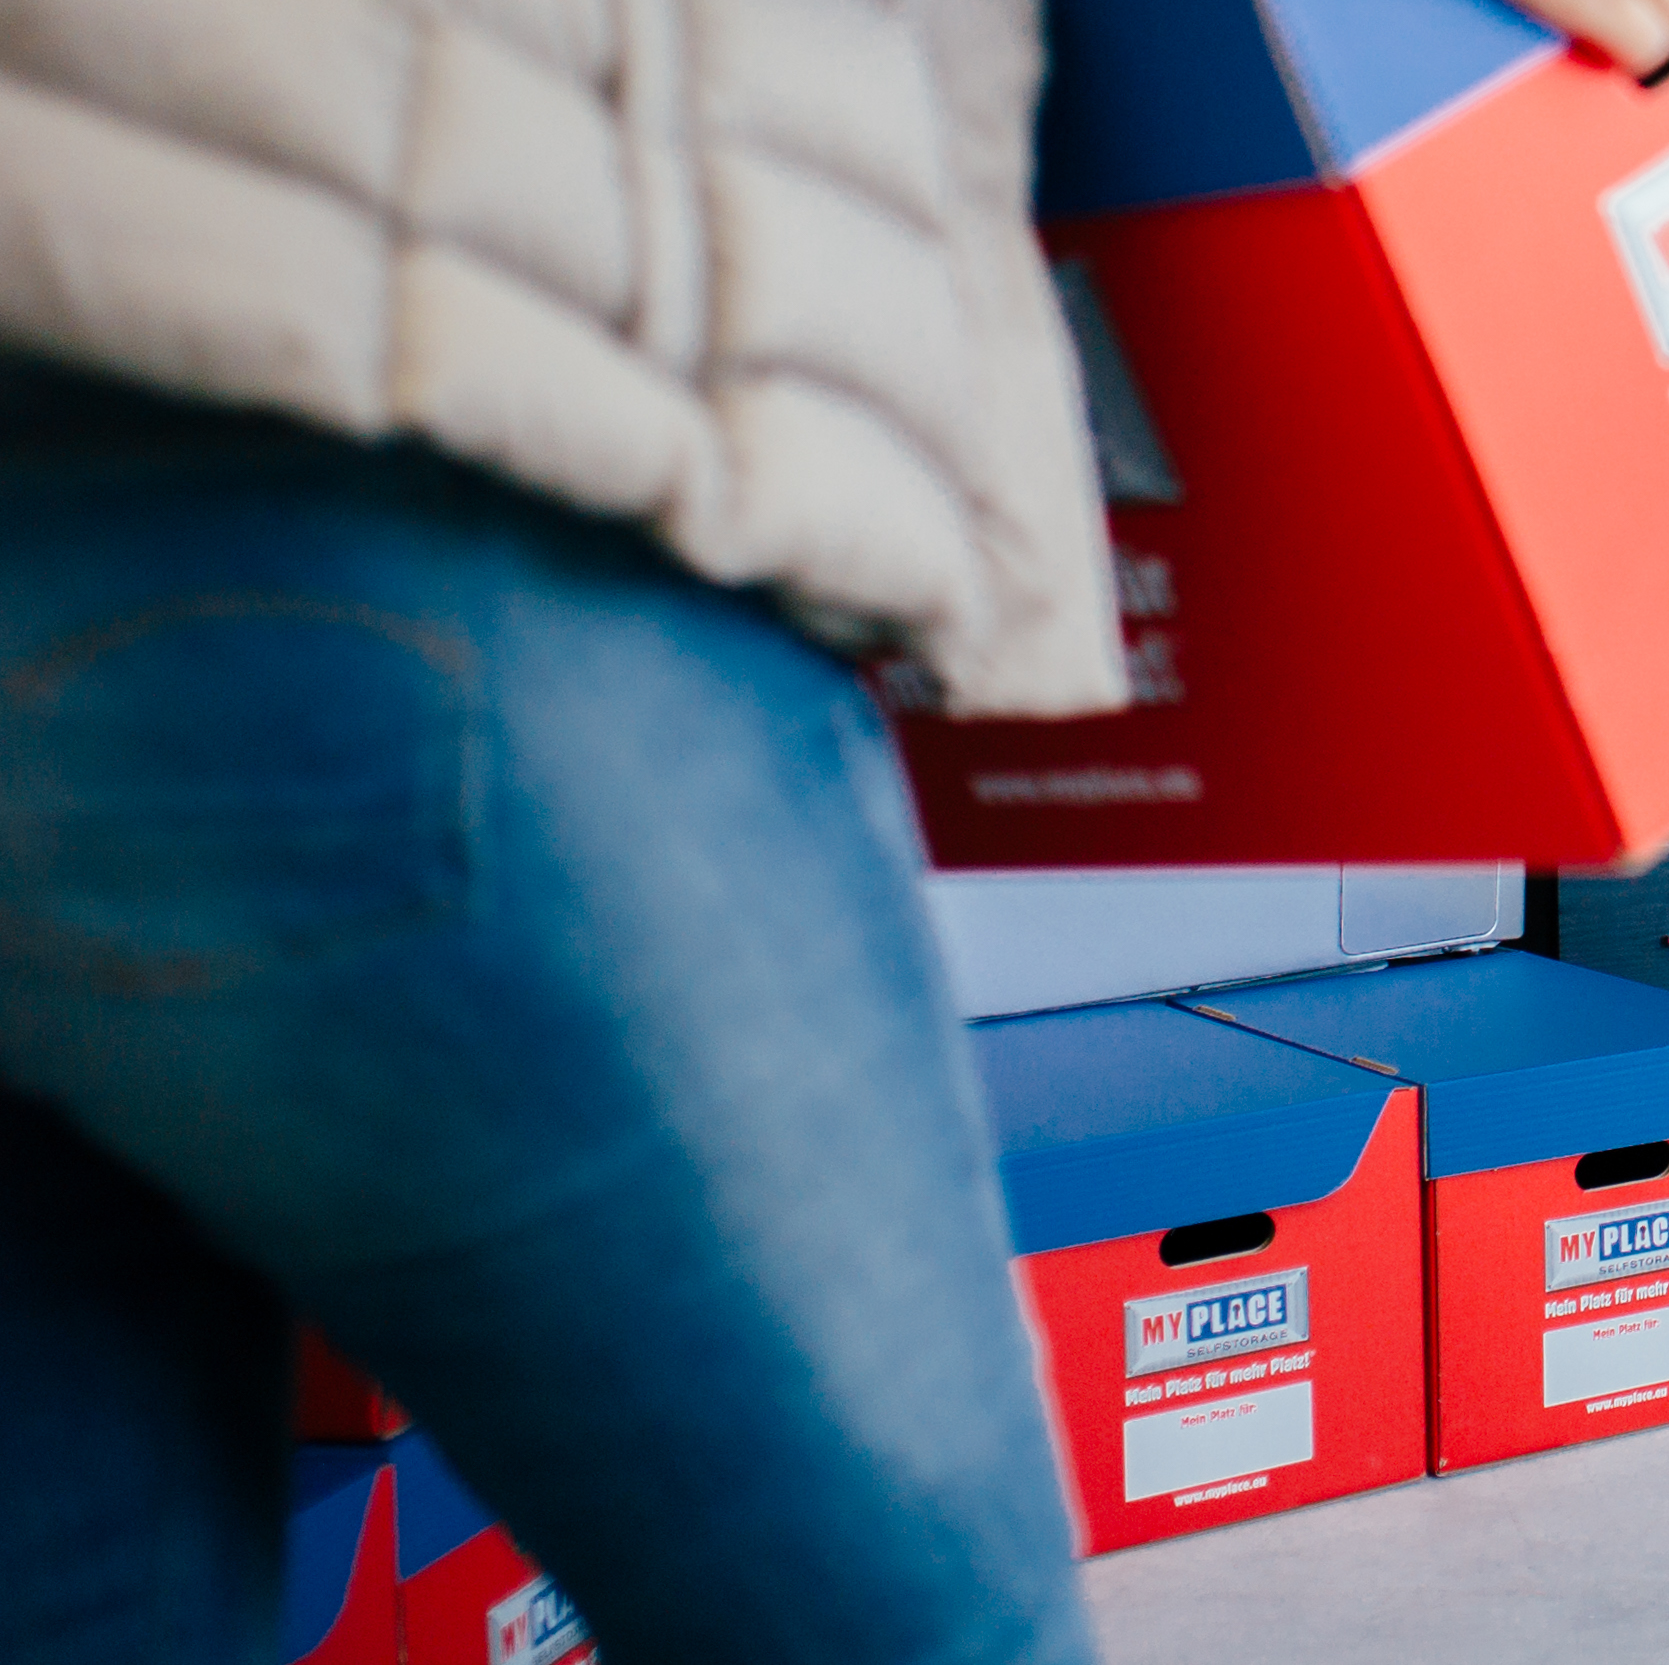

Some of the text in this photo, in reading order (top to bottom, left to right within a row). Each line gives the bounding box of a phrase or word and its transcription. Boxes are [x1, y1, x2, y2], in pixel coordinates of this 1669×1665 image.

[1560, 1231, 1596, 1263] MY
[1545, 1300, 1577, 1320] Mein
[1580, 1294, 1612, 1312] Platz
[1615, 1288, 1634, 1306] für
[1636, 1282, 1669, 1302] mehr
[1141, 1290, 1284, 1347] MY PLACE
[1592, 1327, 1616, 1341] Mein
[1619, 1323, 1641, 1337] Platz
[1187, 1328, 1289, 1359] SELFSTORAGE
[1125, 1351, 1311, 1407] Mein Platz für mehr Platz!
[1586, 1386, 1669, 1414] www.myplace.eu
[1180, 1410, 1206, 1429] Mein
[1210, 1404, 1236, 1423] Platz
[1174, 1475, 1268, 1508] www.myplace.eu
